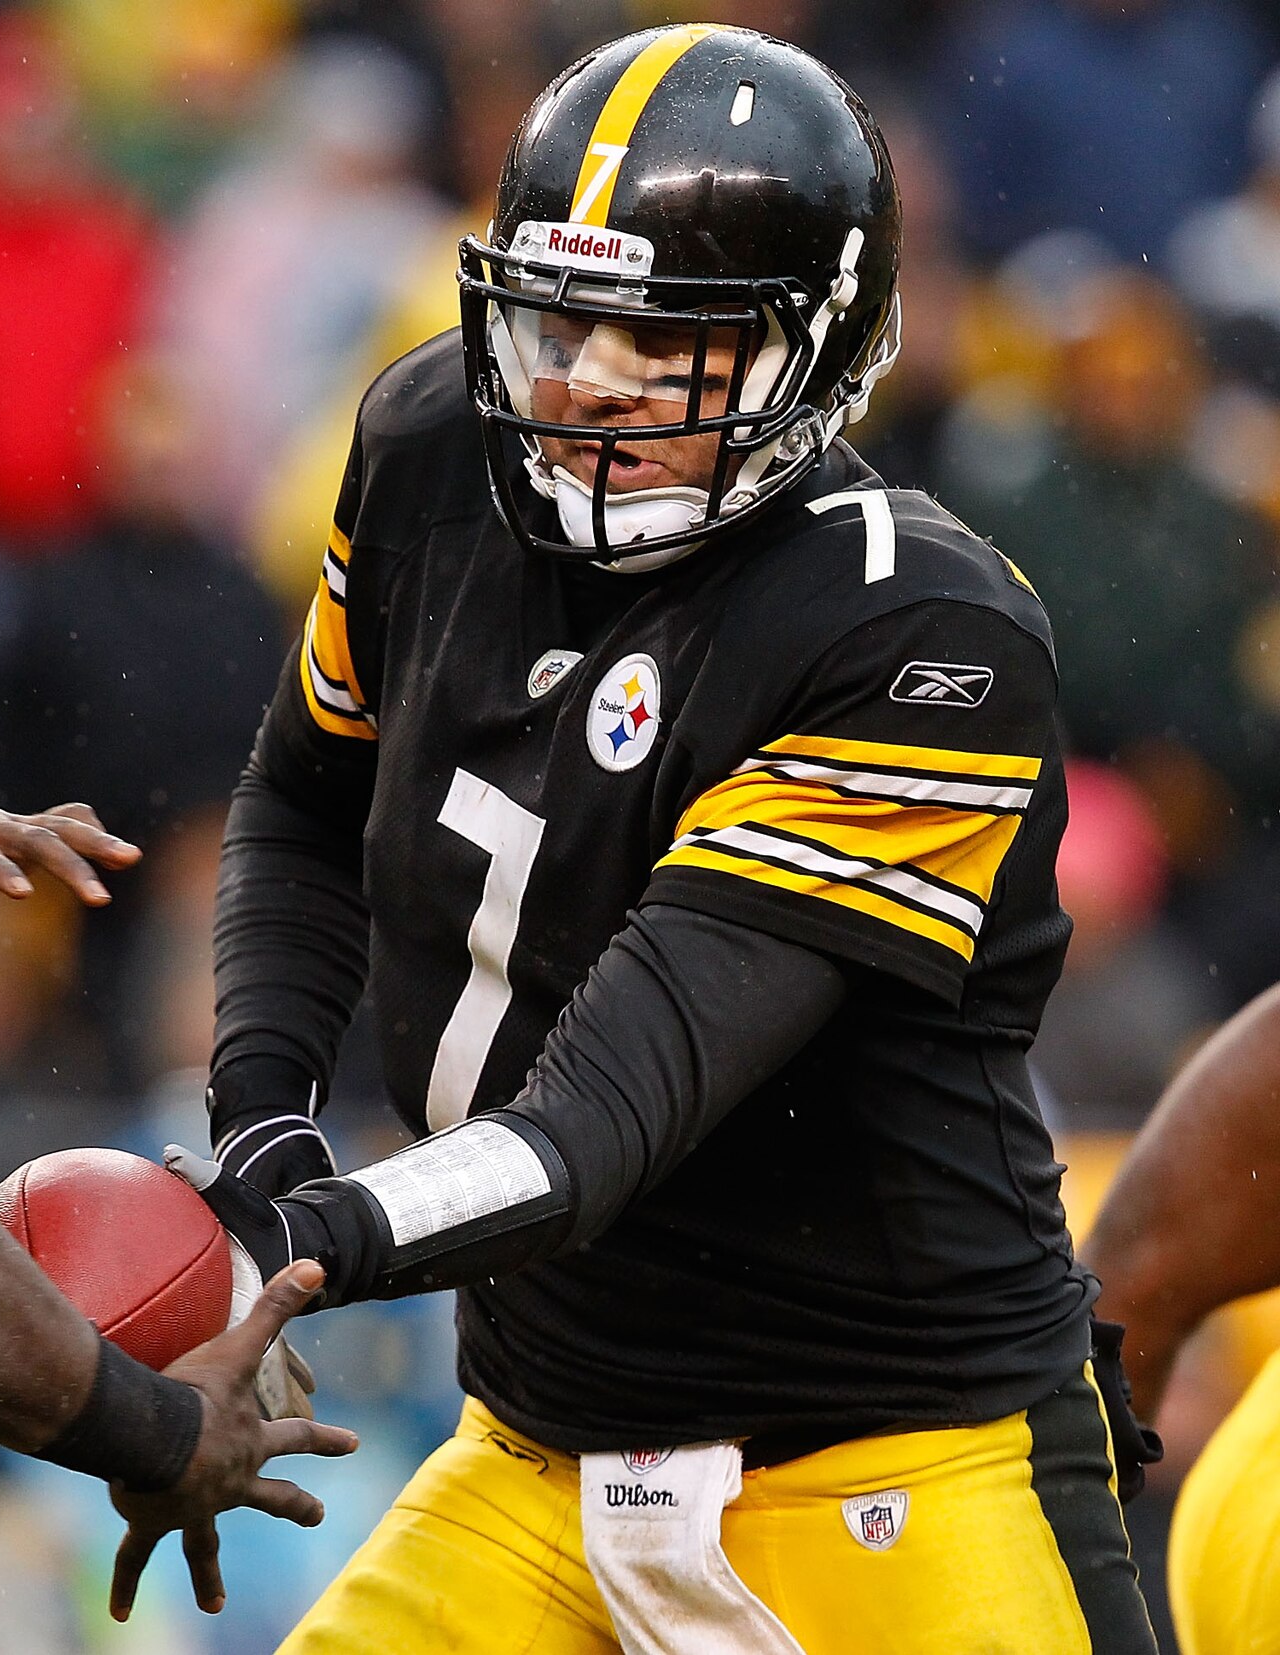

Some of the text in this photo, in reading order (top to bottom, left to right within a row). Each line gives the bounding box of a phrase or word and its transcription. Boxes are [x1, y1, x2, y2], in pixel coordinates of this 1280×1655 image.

[569, 142, 631, 223] 7
[548, 229, 622, 260] Riddell
[805, 489, 896, 585] 7
[598, 698, 625, 715] Steelers
[436, 767, 547, 1132] 7
[605, 1483, 673, 1507] Wilson
[865, 1519, 891, 1540] NFL
